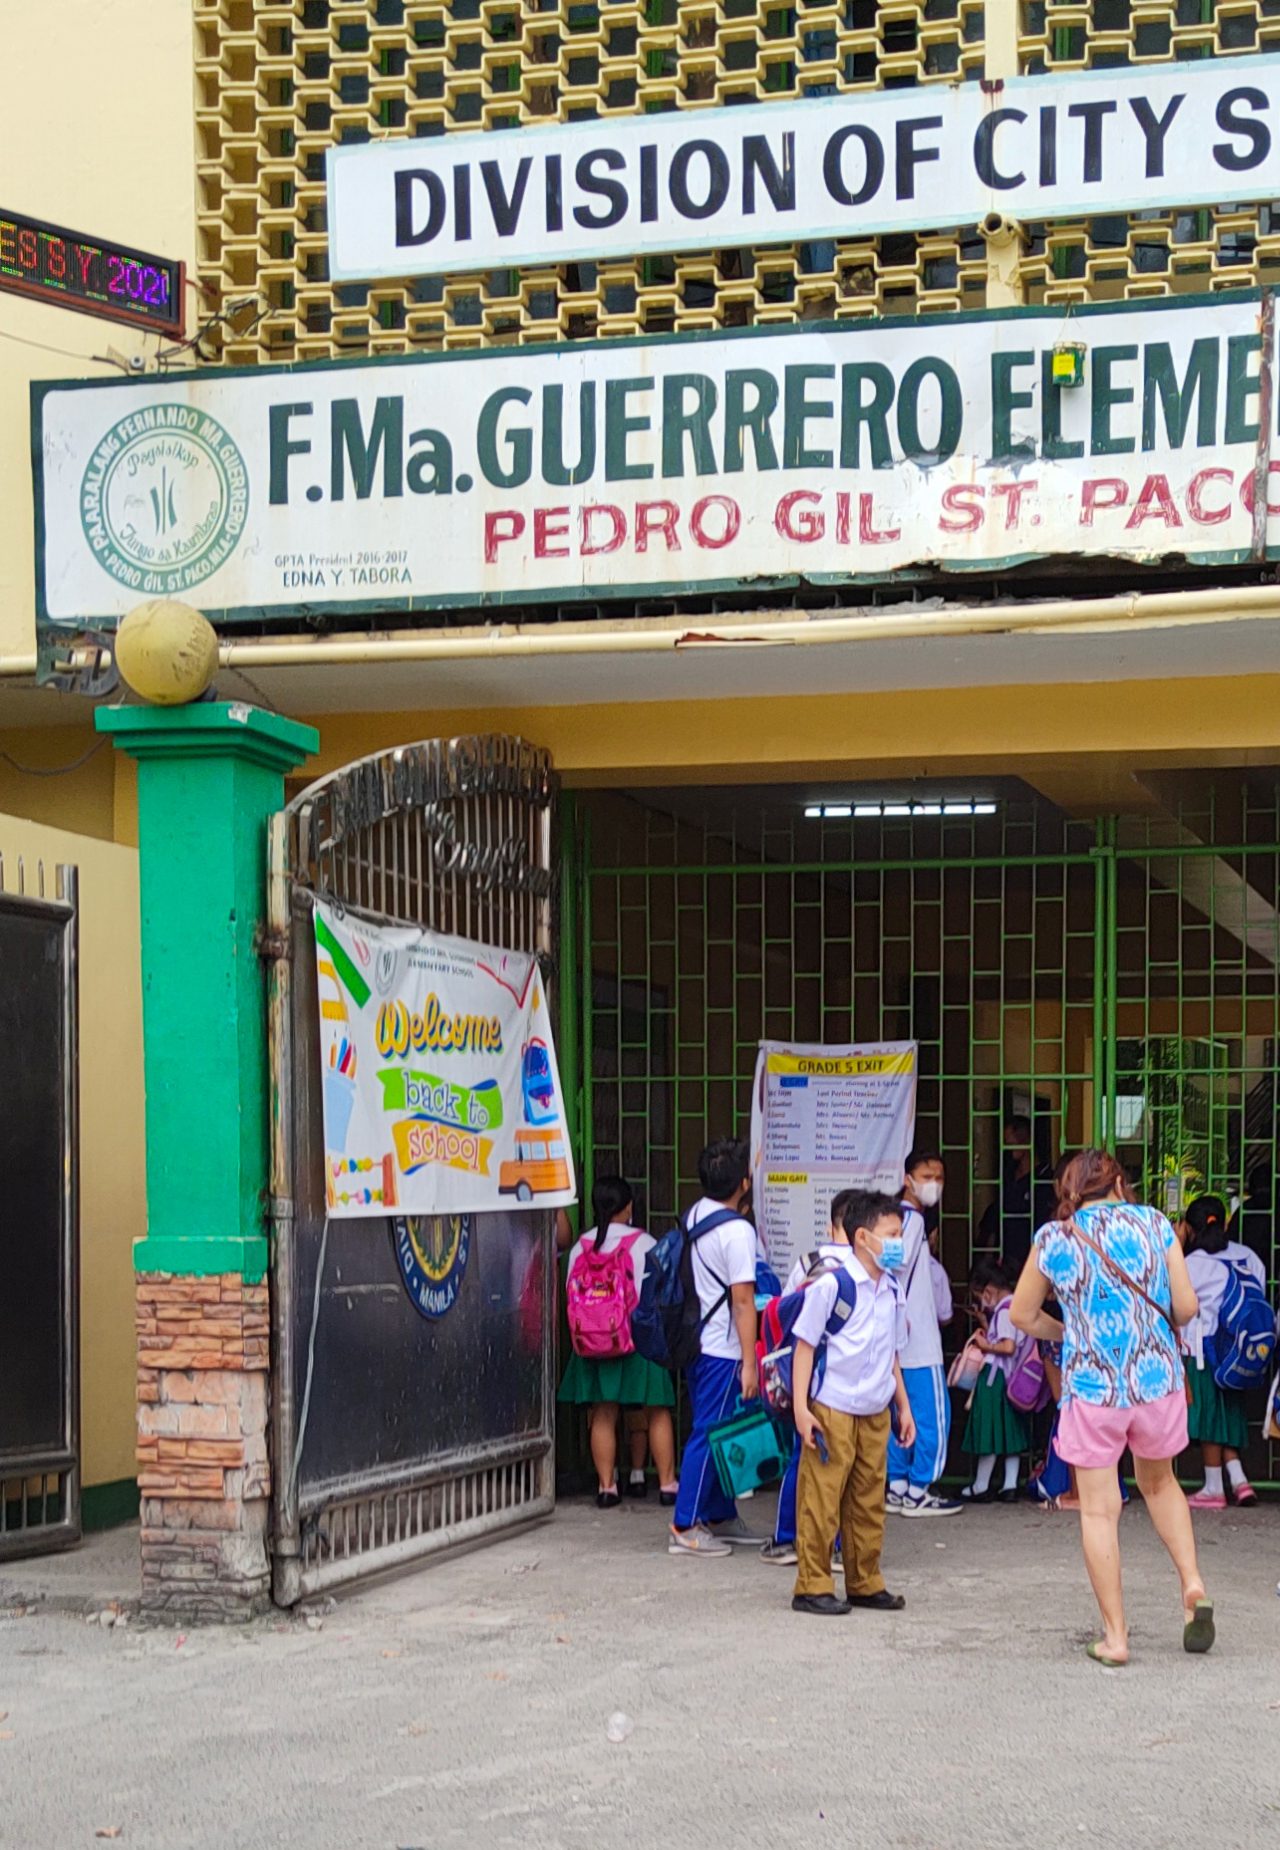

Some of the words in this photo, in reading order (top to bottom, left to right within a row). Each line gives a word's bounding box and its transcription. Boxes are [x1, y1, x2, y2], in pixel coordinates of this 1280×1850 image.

[395, 131, 796, 247] DIVISION
[823, 116, 943, 206] OF
[973, 94, 1187, 191] CITY
[116, 406, 199, 442] FERNANDO
[484, 494, 742, 565] PEDRO
[775, 488, 902, 546] GIL
[938, 479, 1041, 534] ST.
[106, 553, 142, 587] PEDRO
[144, 572, 164, 592] GIL
[283, 569, 326, 588] EDNA
[350, 567, 412, 585] TABORA
[375, 991, 504, 1060] Welcome
[798, 1060, 842, 1074] GRADE
[845, 1060, 854, 1074] 5
[857, 1060, 885, 1073] EXIT
[402, 1071, 460, 1120] back
[468, 1092, 489, 1125] to
[408, 1124, 480, 1171] school
[768, 1174, 787, 1183] MAIN
[789, 1174, 808, 1183] GATE
[419, 1281, 454, 1314] MANILA
